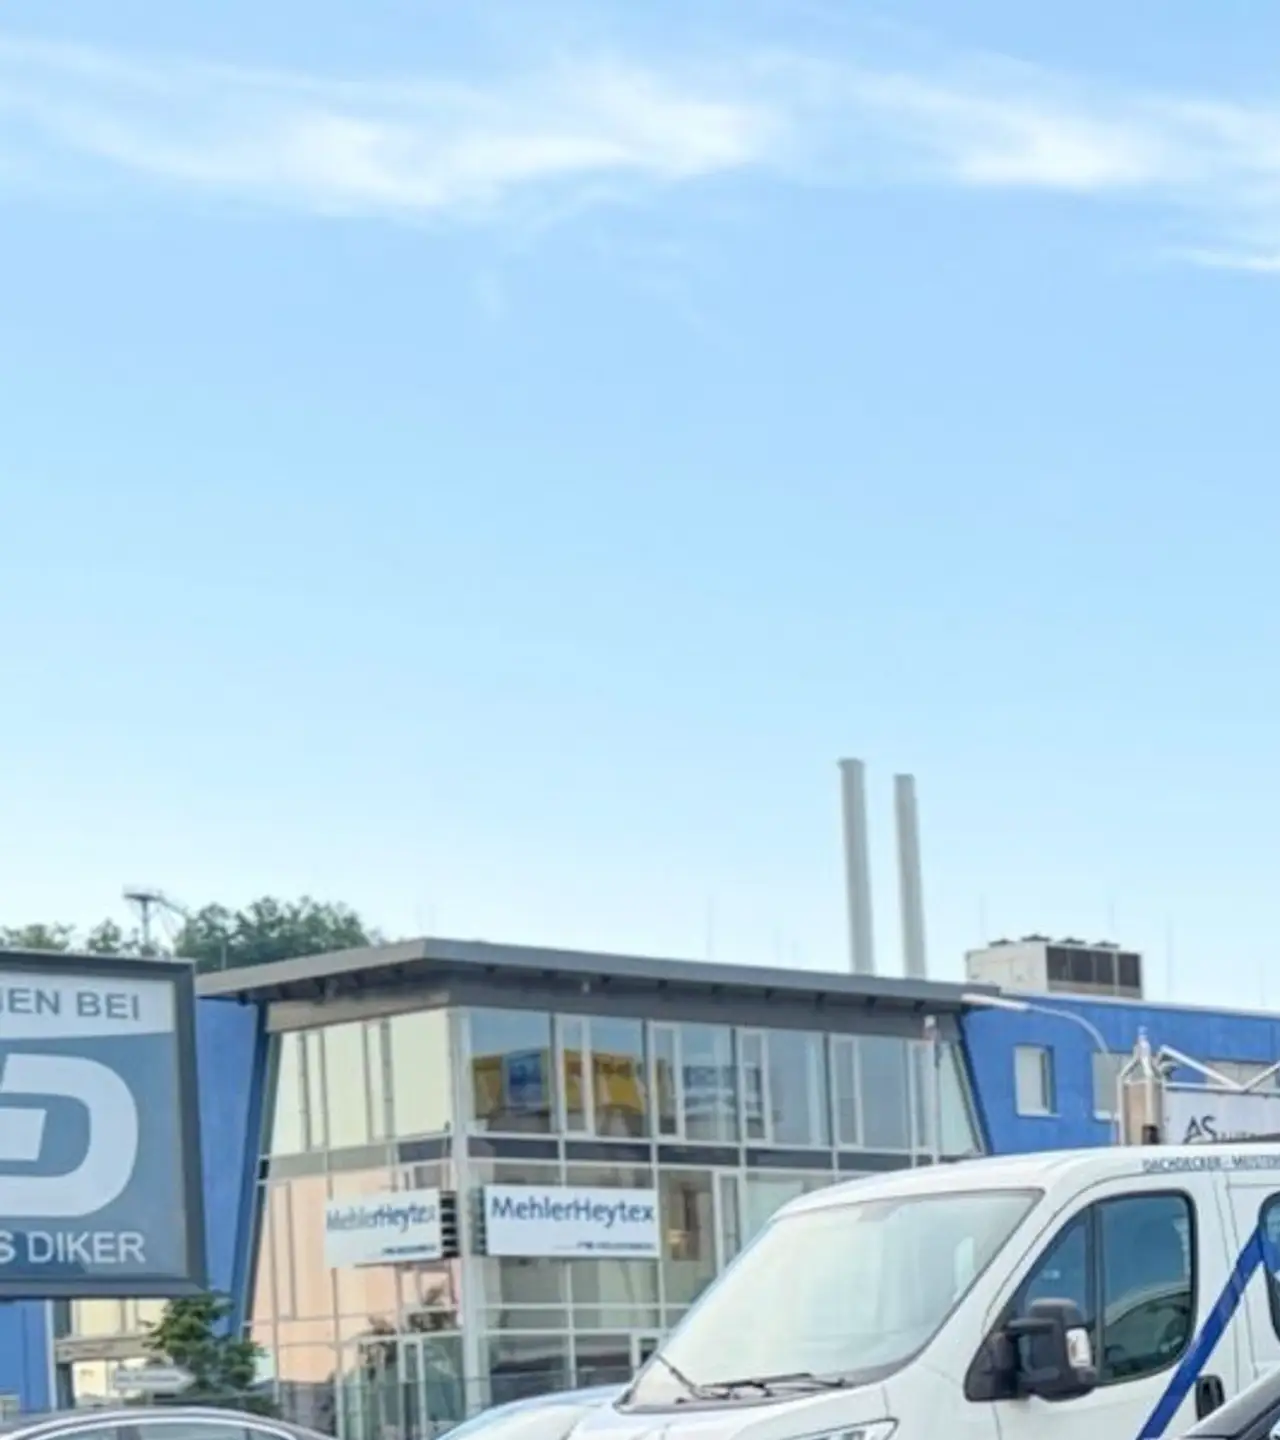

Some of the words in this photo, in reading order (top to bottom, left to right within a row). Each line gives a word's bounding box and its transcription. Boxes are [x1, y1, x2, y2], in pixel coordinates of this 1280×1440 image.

[0, 987, 60, 1016] EN
[76, 991, 140, 1021] BEI
[491, 1197, 655, 1229] MehlerHeytex
[27, 1230, 147, 1265] DIKER
